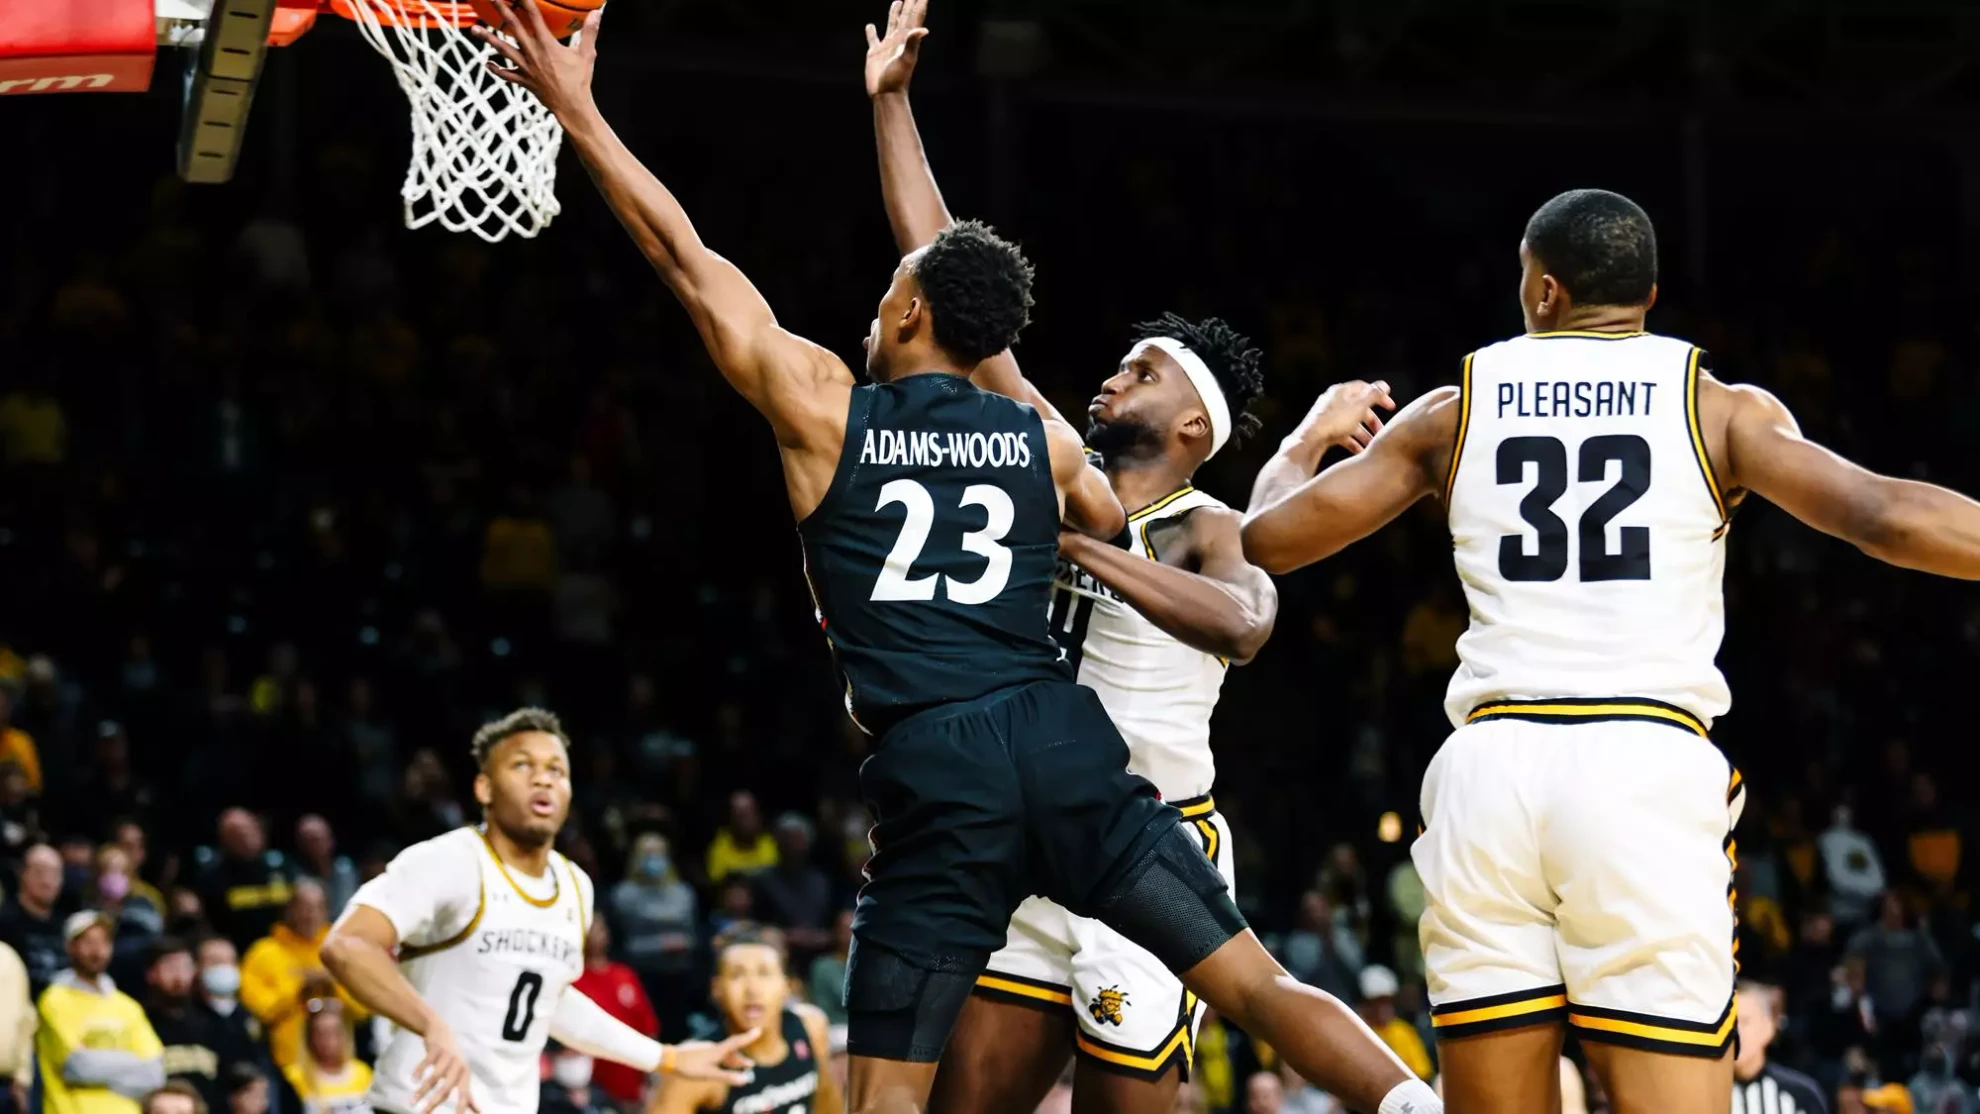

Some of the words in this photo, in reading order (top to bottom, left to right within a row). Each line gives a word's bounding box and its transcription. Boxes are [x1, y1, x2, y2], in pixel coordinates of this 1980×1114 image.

[1498, 381, 1657, 418] PLEASANT
[860, 429, 1031, 468] ADAMS-WOODS
[869, 479, 1015, 605] 23
[1496, 434, 1651, 582] 32
[502, 969, 543, 1042] 0
